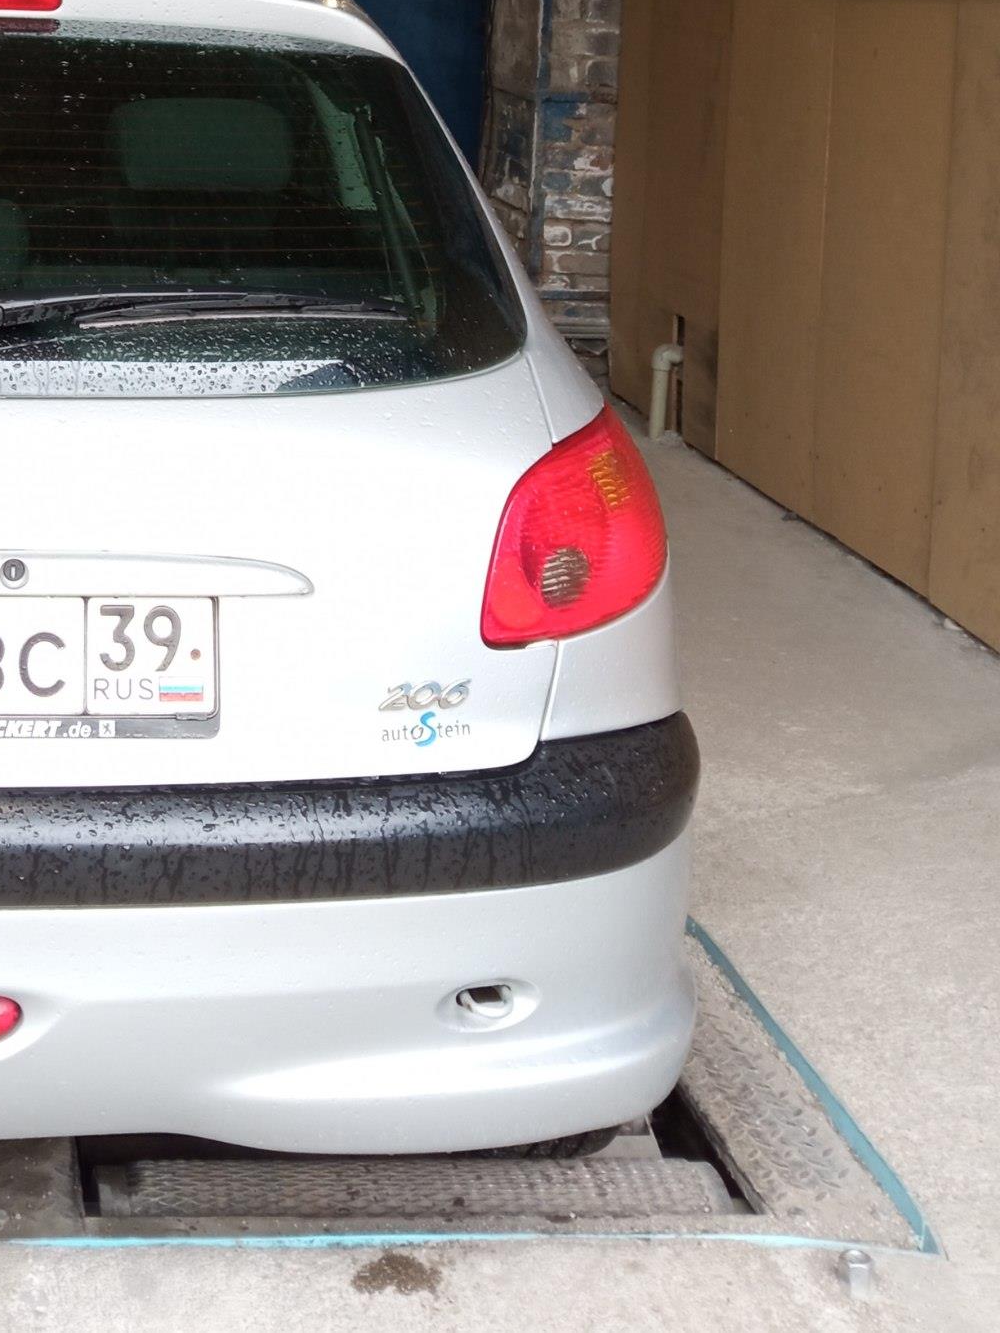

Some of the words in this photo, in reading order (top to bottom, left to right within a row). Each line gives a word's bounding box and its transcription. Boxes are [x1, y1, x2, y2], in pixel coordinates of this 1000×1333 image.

[99, 604, 182, 672] 39
[93, 677, 154, 700] RUS
[377, 678, 472, 712] 206
[381, 711, 471, 747] autoStein
